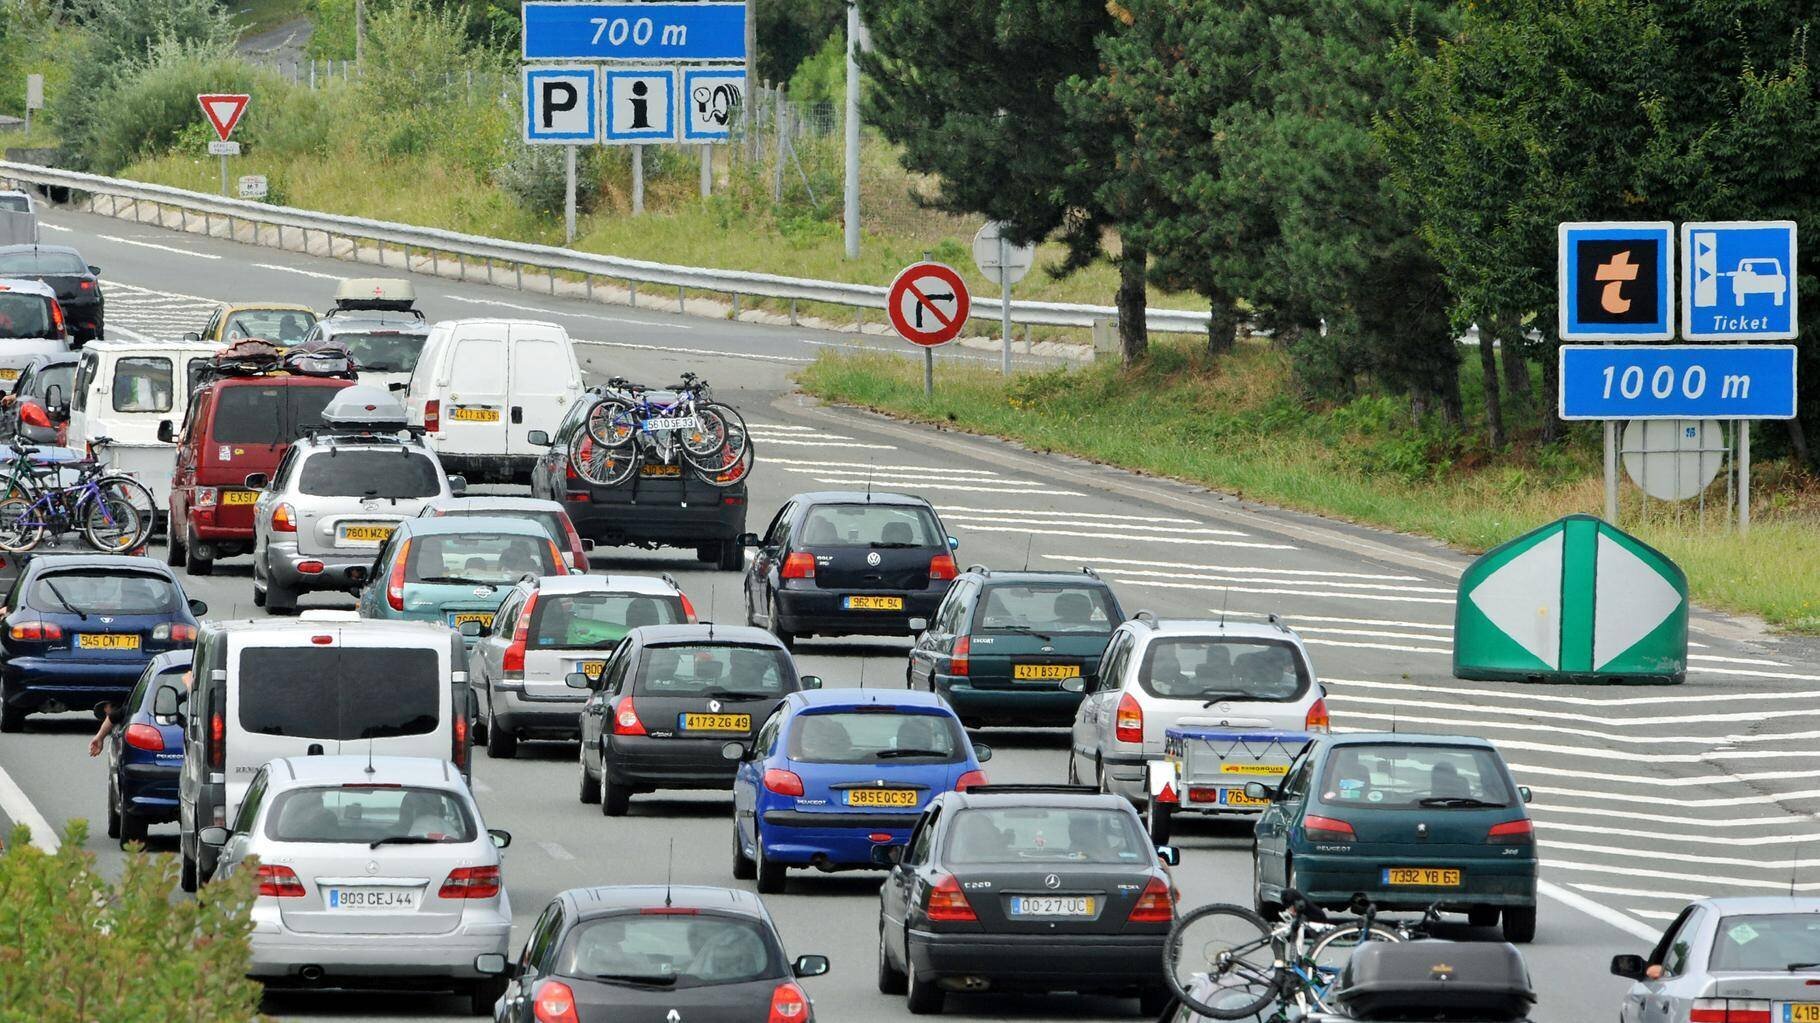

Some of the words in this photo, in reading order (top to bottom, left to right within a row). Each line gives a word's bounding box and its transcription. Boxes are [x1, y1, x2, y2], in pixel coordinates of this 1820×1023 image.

[590, 17, 653, 46] 700
[661, 24, 687, 46] m
[542, 81, 578, 128] P
[1595, 250, 1640, 314] t
[1713, 315, 1768, 331] Ticket
[1602, 365, 1706, 399] 1000
[1721, 373, 1751, 399] m
[648, 419, 669, 429] 5610
[672, 418, 681, 427] SE
[683, 417, 693, 427] 33
[853, 598, 870, 607] 962
[873, 598, 883, 608] YC
[888, 598, 898, 608] 94
[81, 635, 99, 646] 945
[102, 635, 120, 646] CNT
[125, 636, 136, 646] 77
[1019, 666, 1038, 677] 421
[1063, 668, 1074, 677] 77
[687, 716, 715, 727] 4173
[718, 716, 731, 727] ZG
[735, 717, 748, 728] 49
[852, 791, 875, 803] 585
[1391, 870, 1420, 882] 7392
[1424, 870, 1438, 882] YB
[1443, 870, 1457, 883] 63
[340, 892, 364, 905] 903
[367, 892, 393, 905] CEJ
[396, 893, 411, 905] 44
